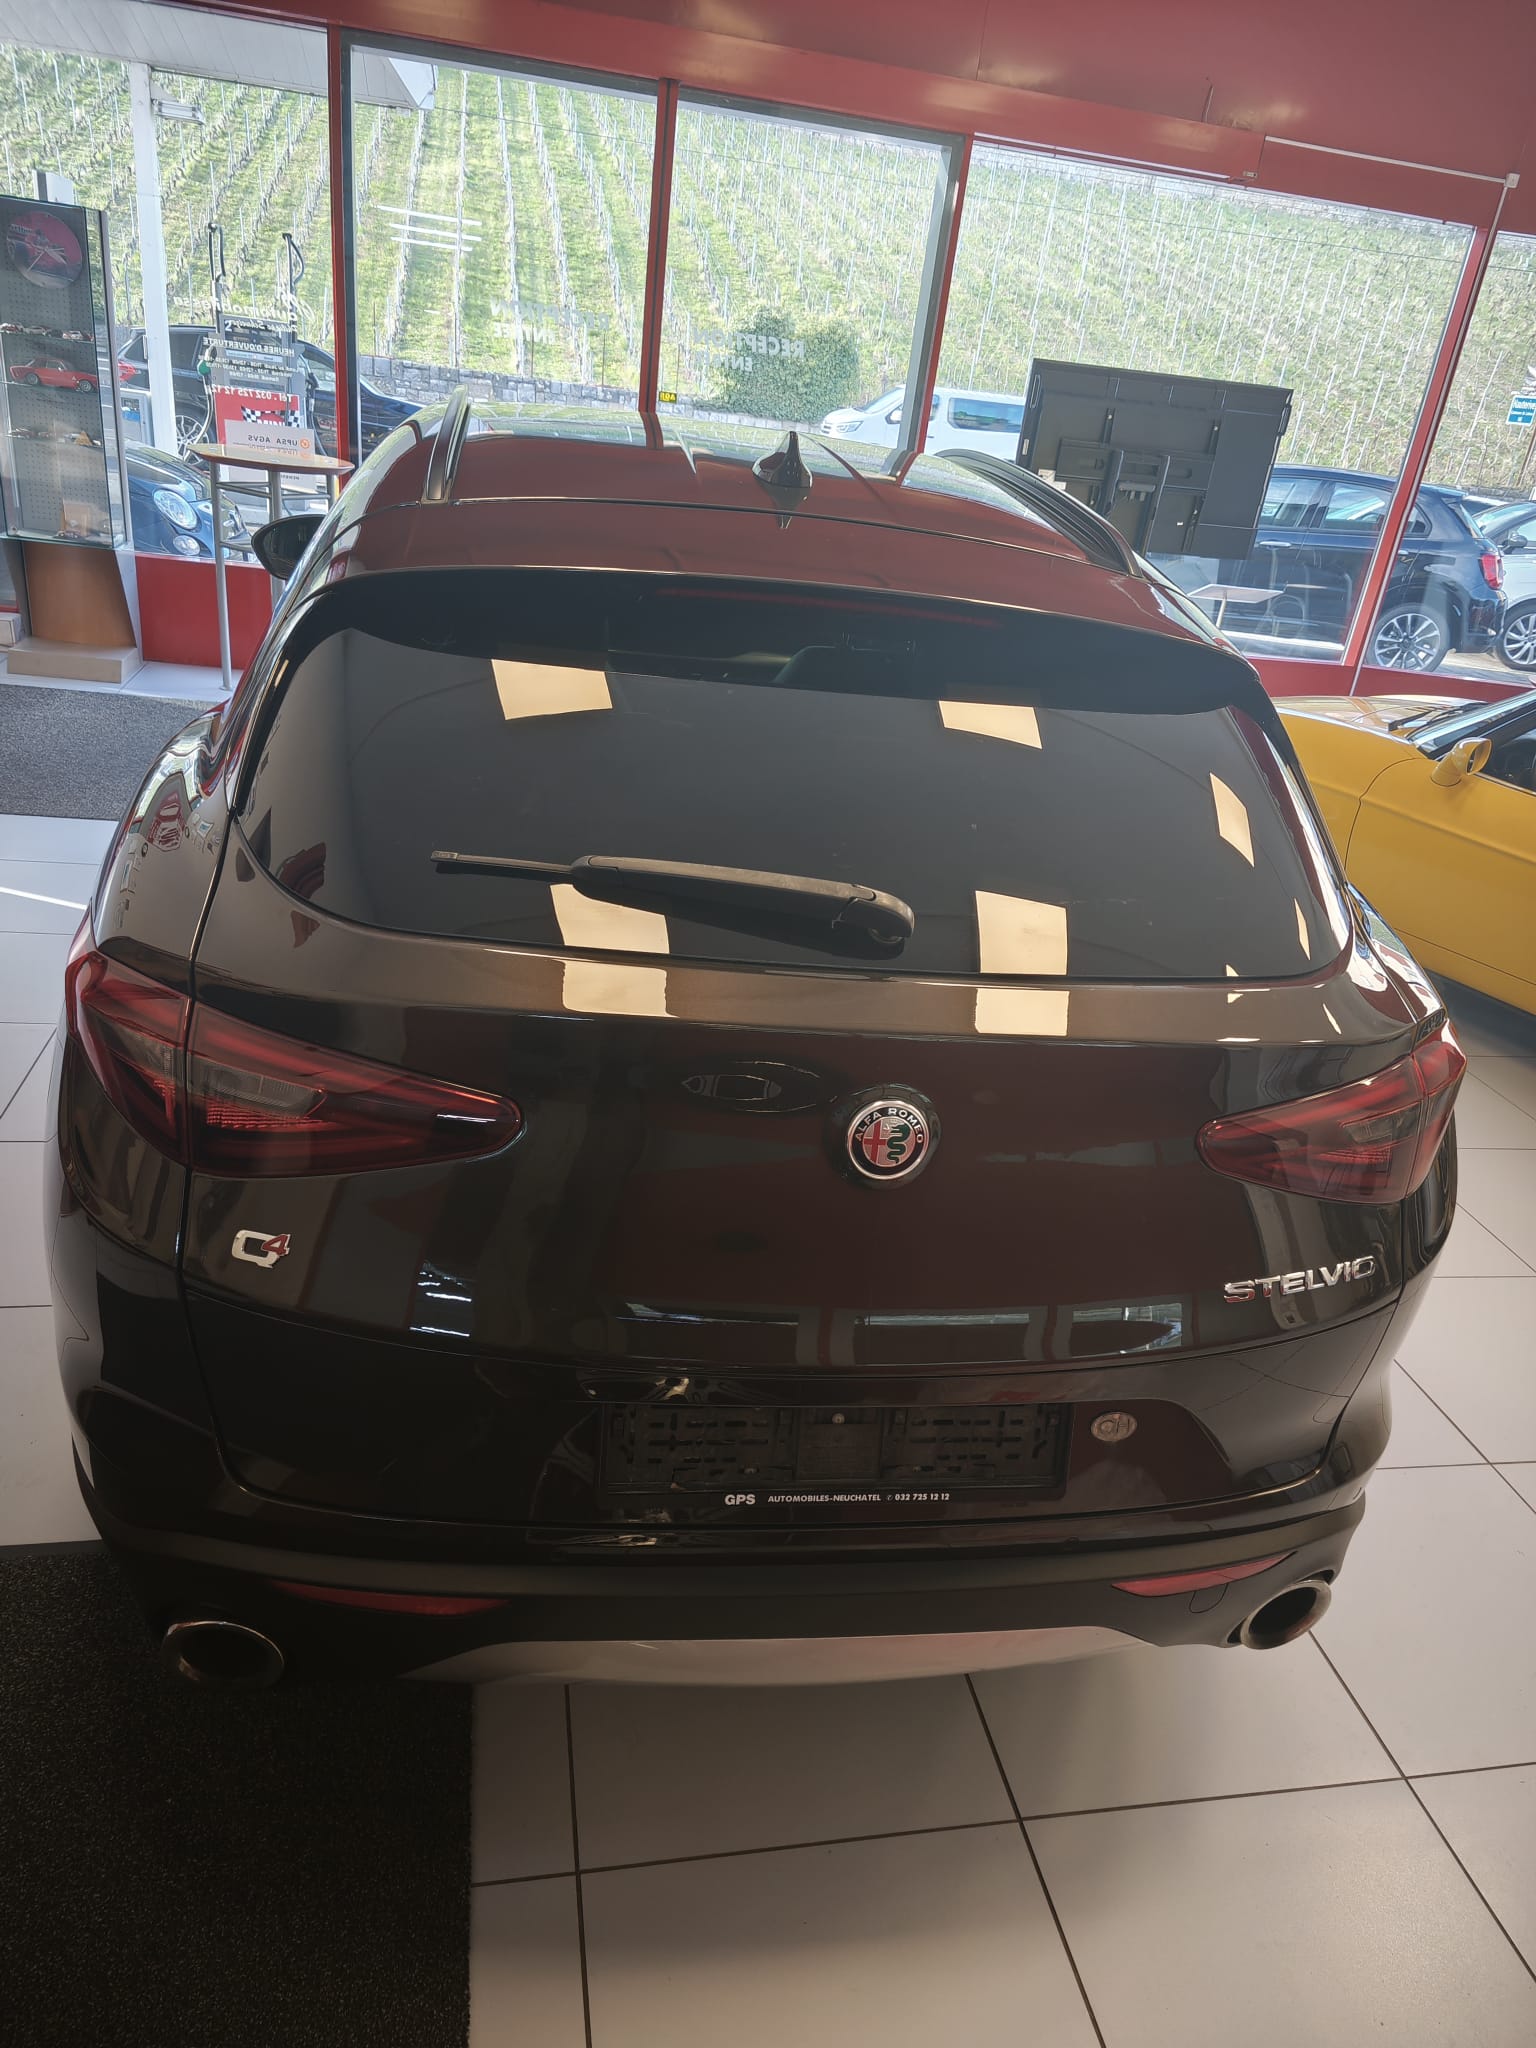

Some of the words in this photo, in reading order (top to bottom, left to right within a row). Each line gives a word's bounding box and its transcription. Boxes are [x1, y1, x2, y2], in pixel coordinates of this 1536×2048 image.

[855, 1111, 882, 1141] ALFA
[887, 1107, 924, 1143] ROMEO
[231, 1229, 291, 1269] Q4
[1223, 1255, 1376, 1304] STELVIO
[1099, 1418, 1130, 1434] CH
[724, 1493, 756, 1506] GPS
[767, 1493, 882, 1503] AUTOMOBILES-NEUCHATEL
[895, 1493, 911, 1501] 032
[912, 1493, 928, 1501] 725
[930, 1493, 939, 1501] 12
[941, 1493, 950, 1501] 12
